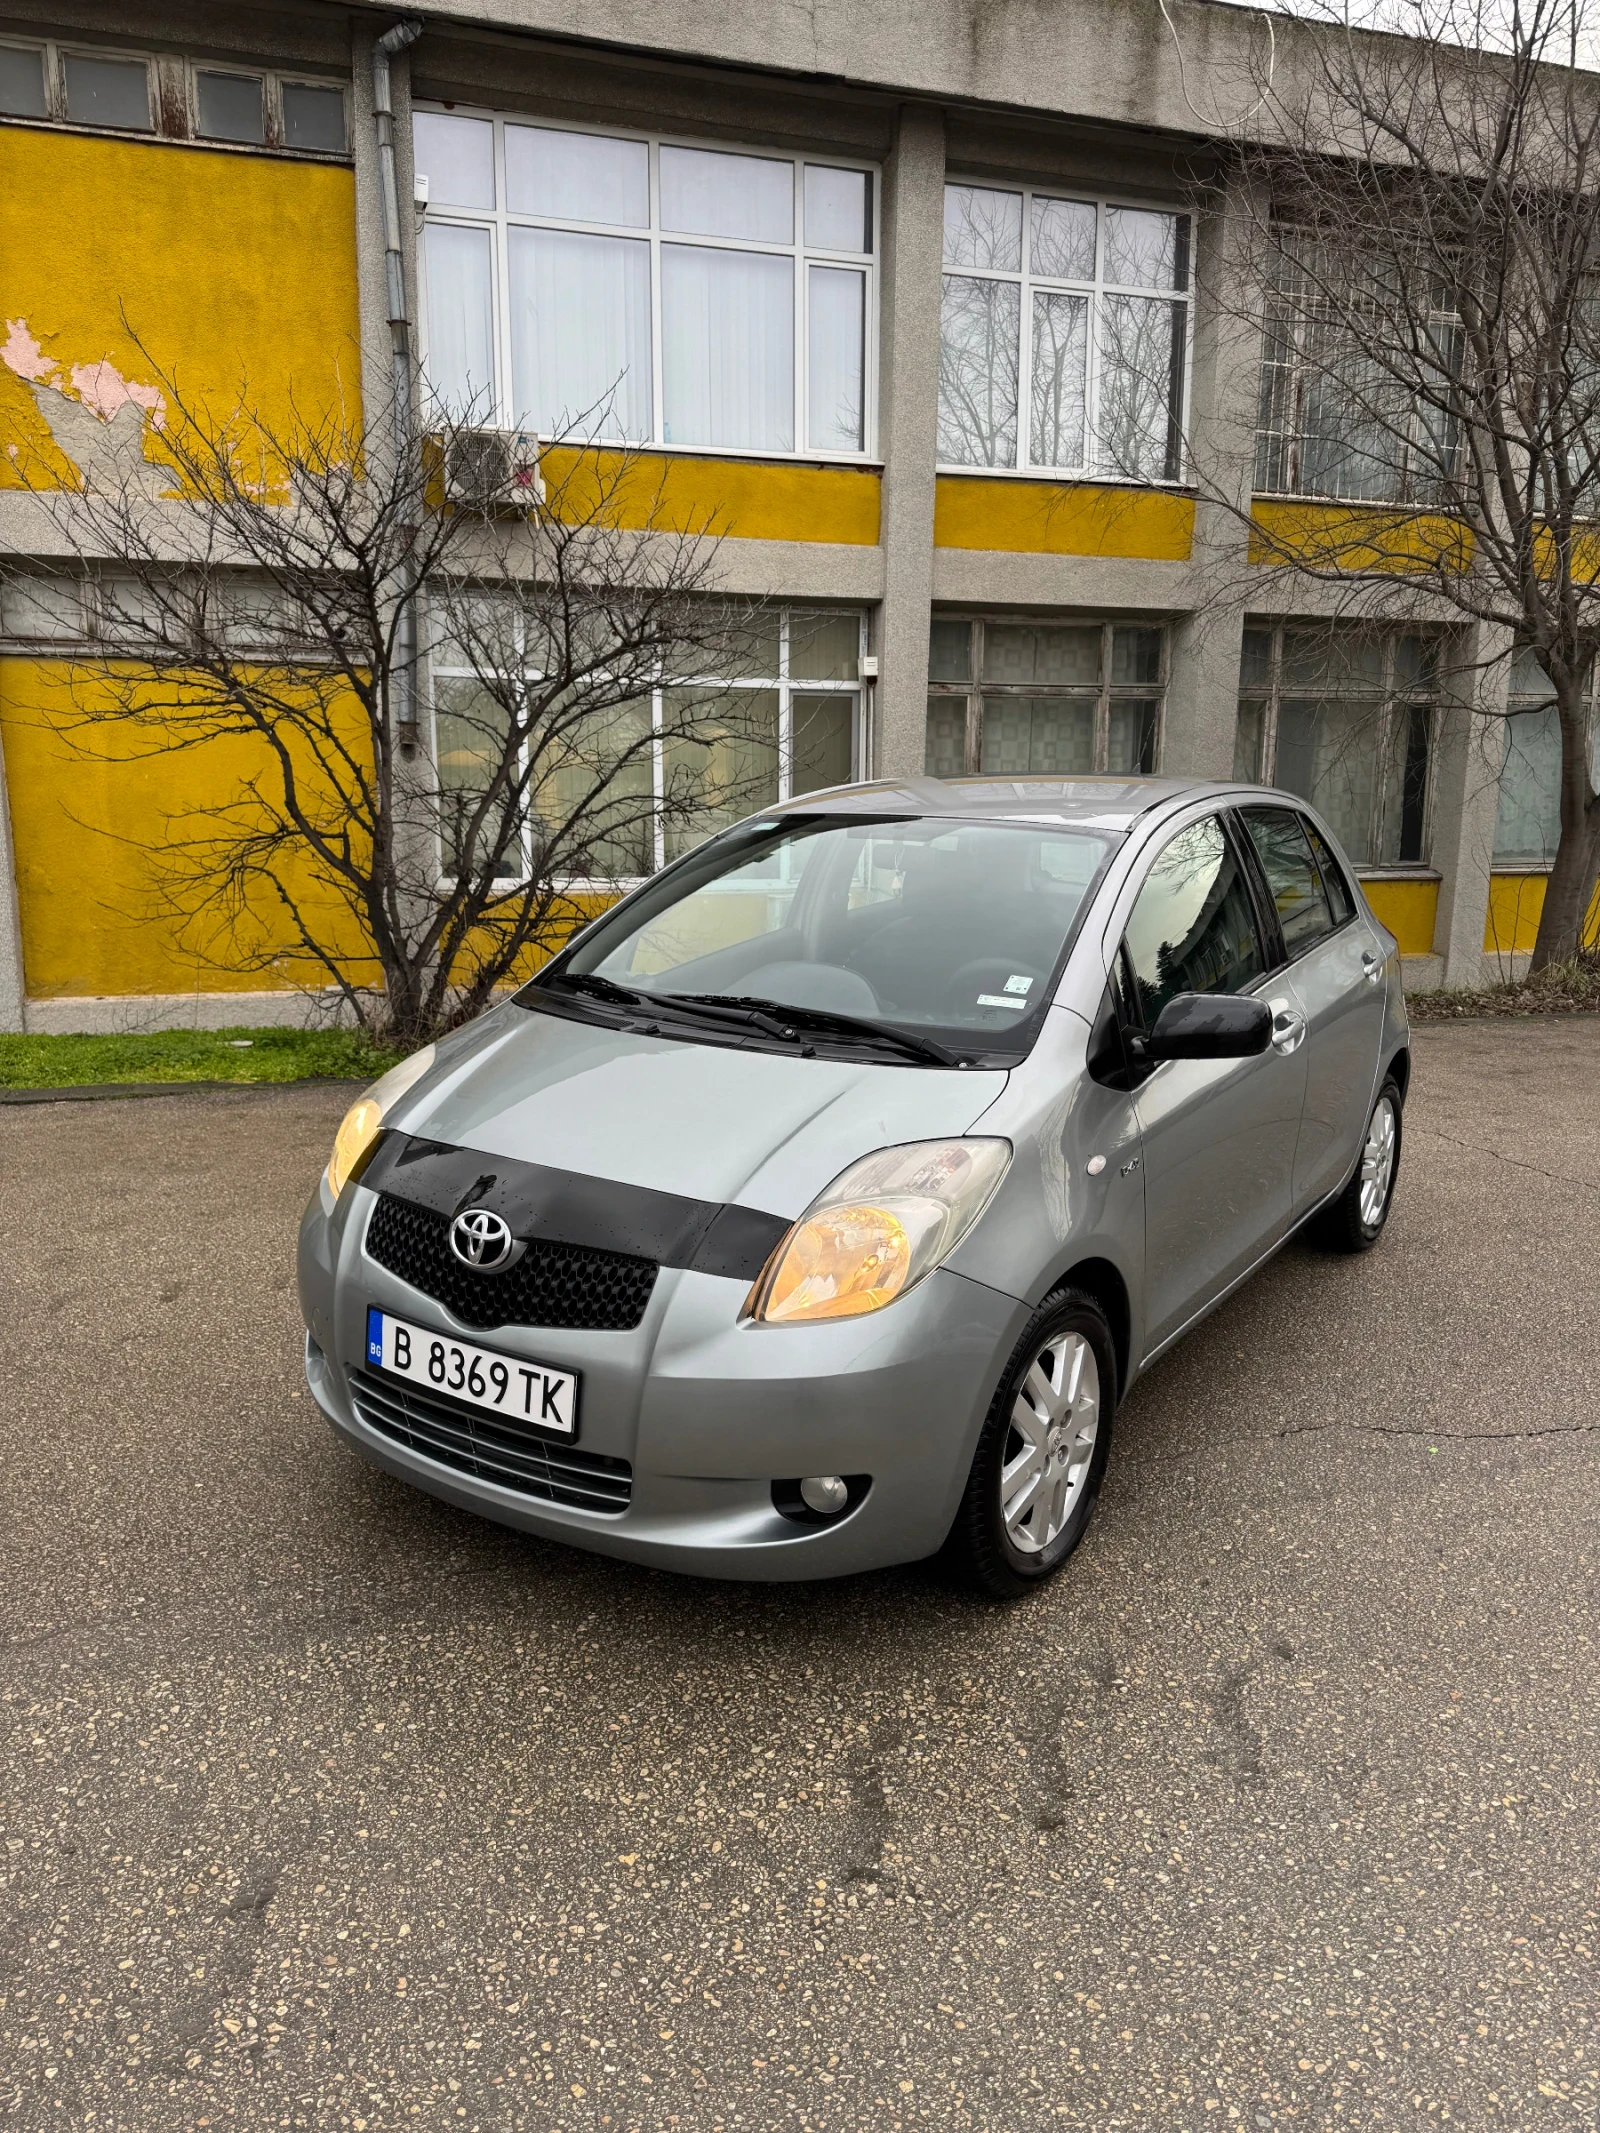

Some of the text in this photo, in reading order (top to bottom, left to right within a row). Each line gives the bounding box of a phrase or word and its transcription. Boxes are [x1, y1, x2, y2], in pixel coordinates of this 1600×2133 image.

[370, 1341, 382, 1357] BG
[394, 1326, 565, 1424] B 8369 TK
